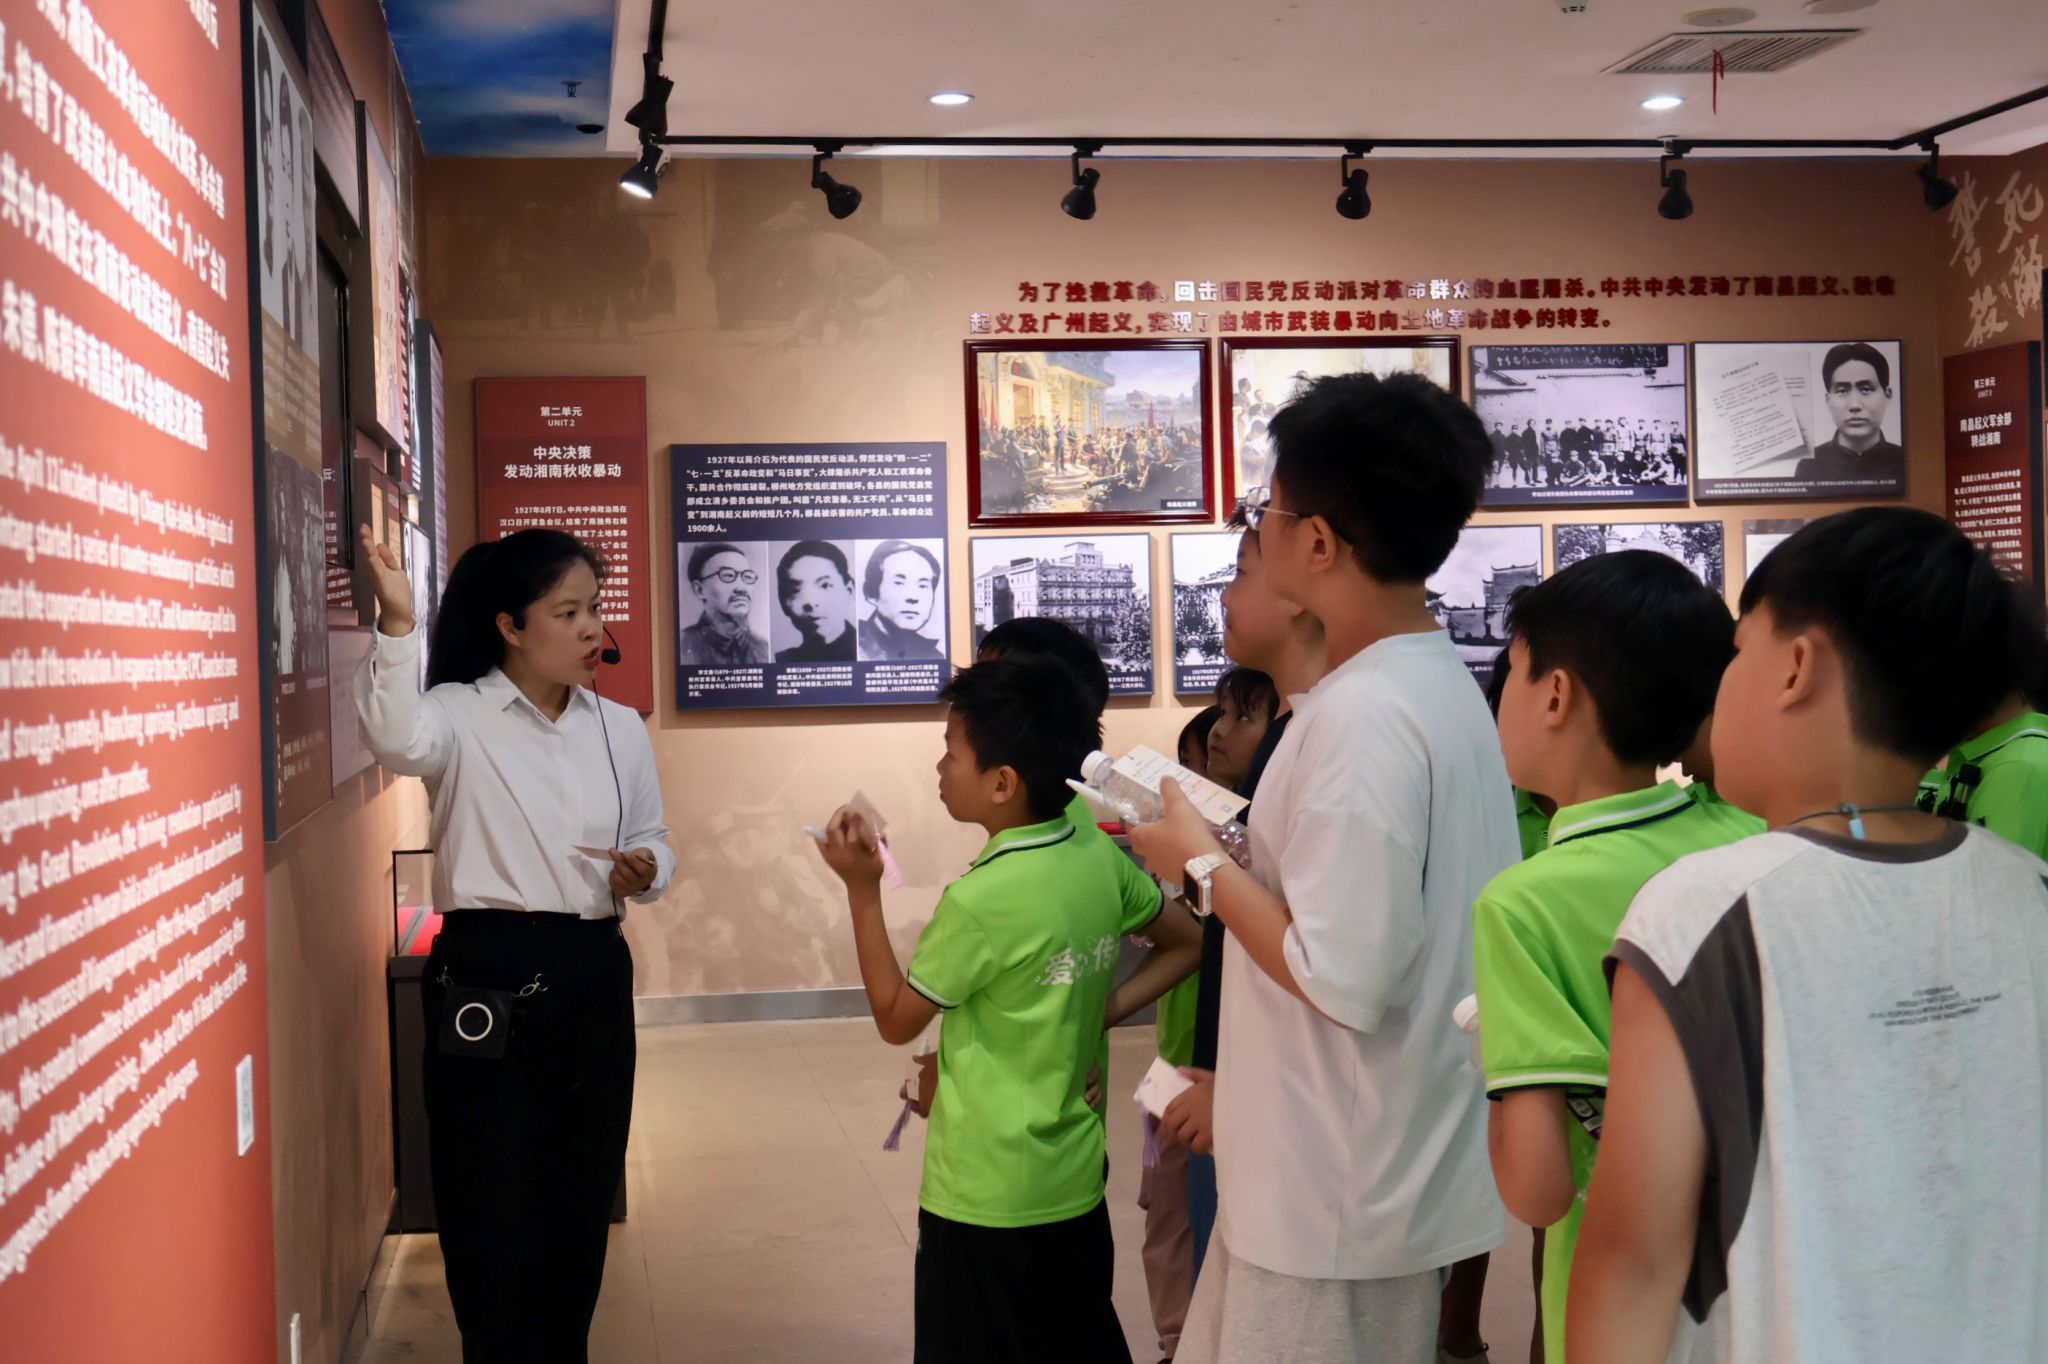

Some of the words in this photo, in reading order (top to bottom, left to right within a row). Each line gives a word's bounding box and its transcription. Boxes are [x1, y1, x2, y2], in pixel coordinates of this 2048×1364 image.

[540, 406, 582, 416] 第二单元
[548, 419, 568, 427] UNIT
[533, 446, 592, 460] 中央决策
[504, 463, 621, 478] 发动湘南秋收暴动
